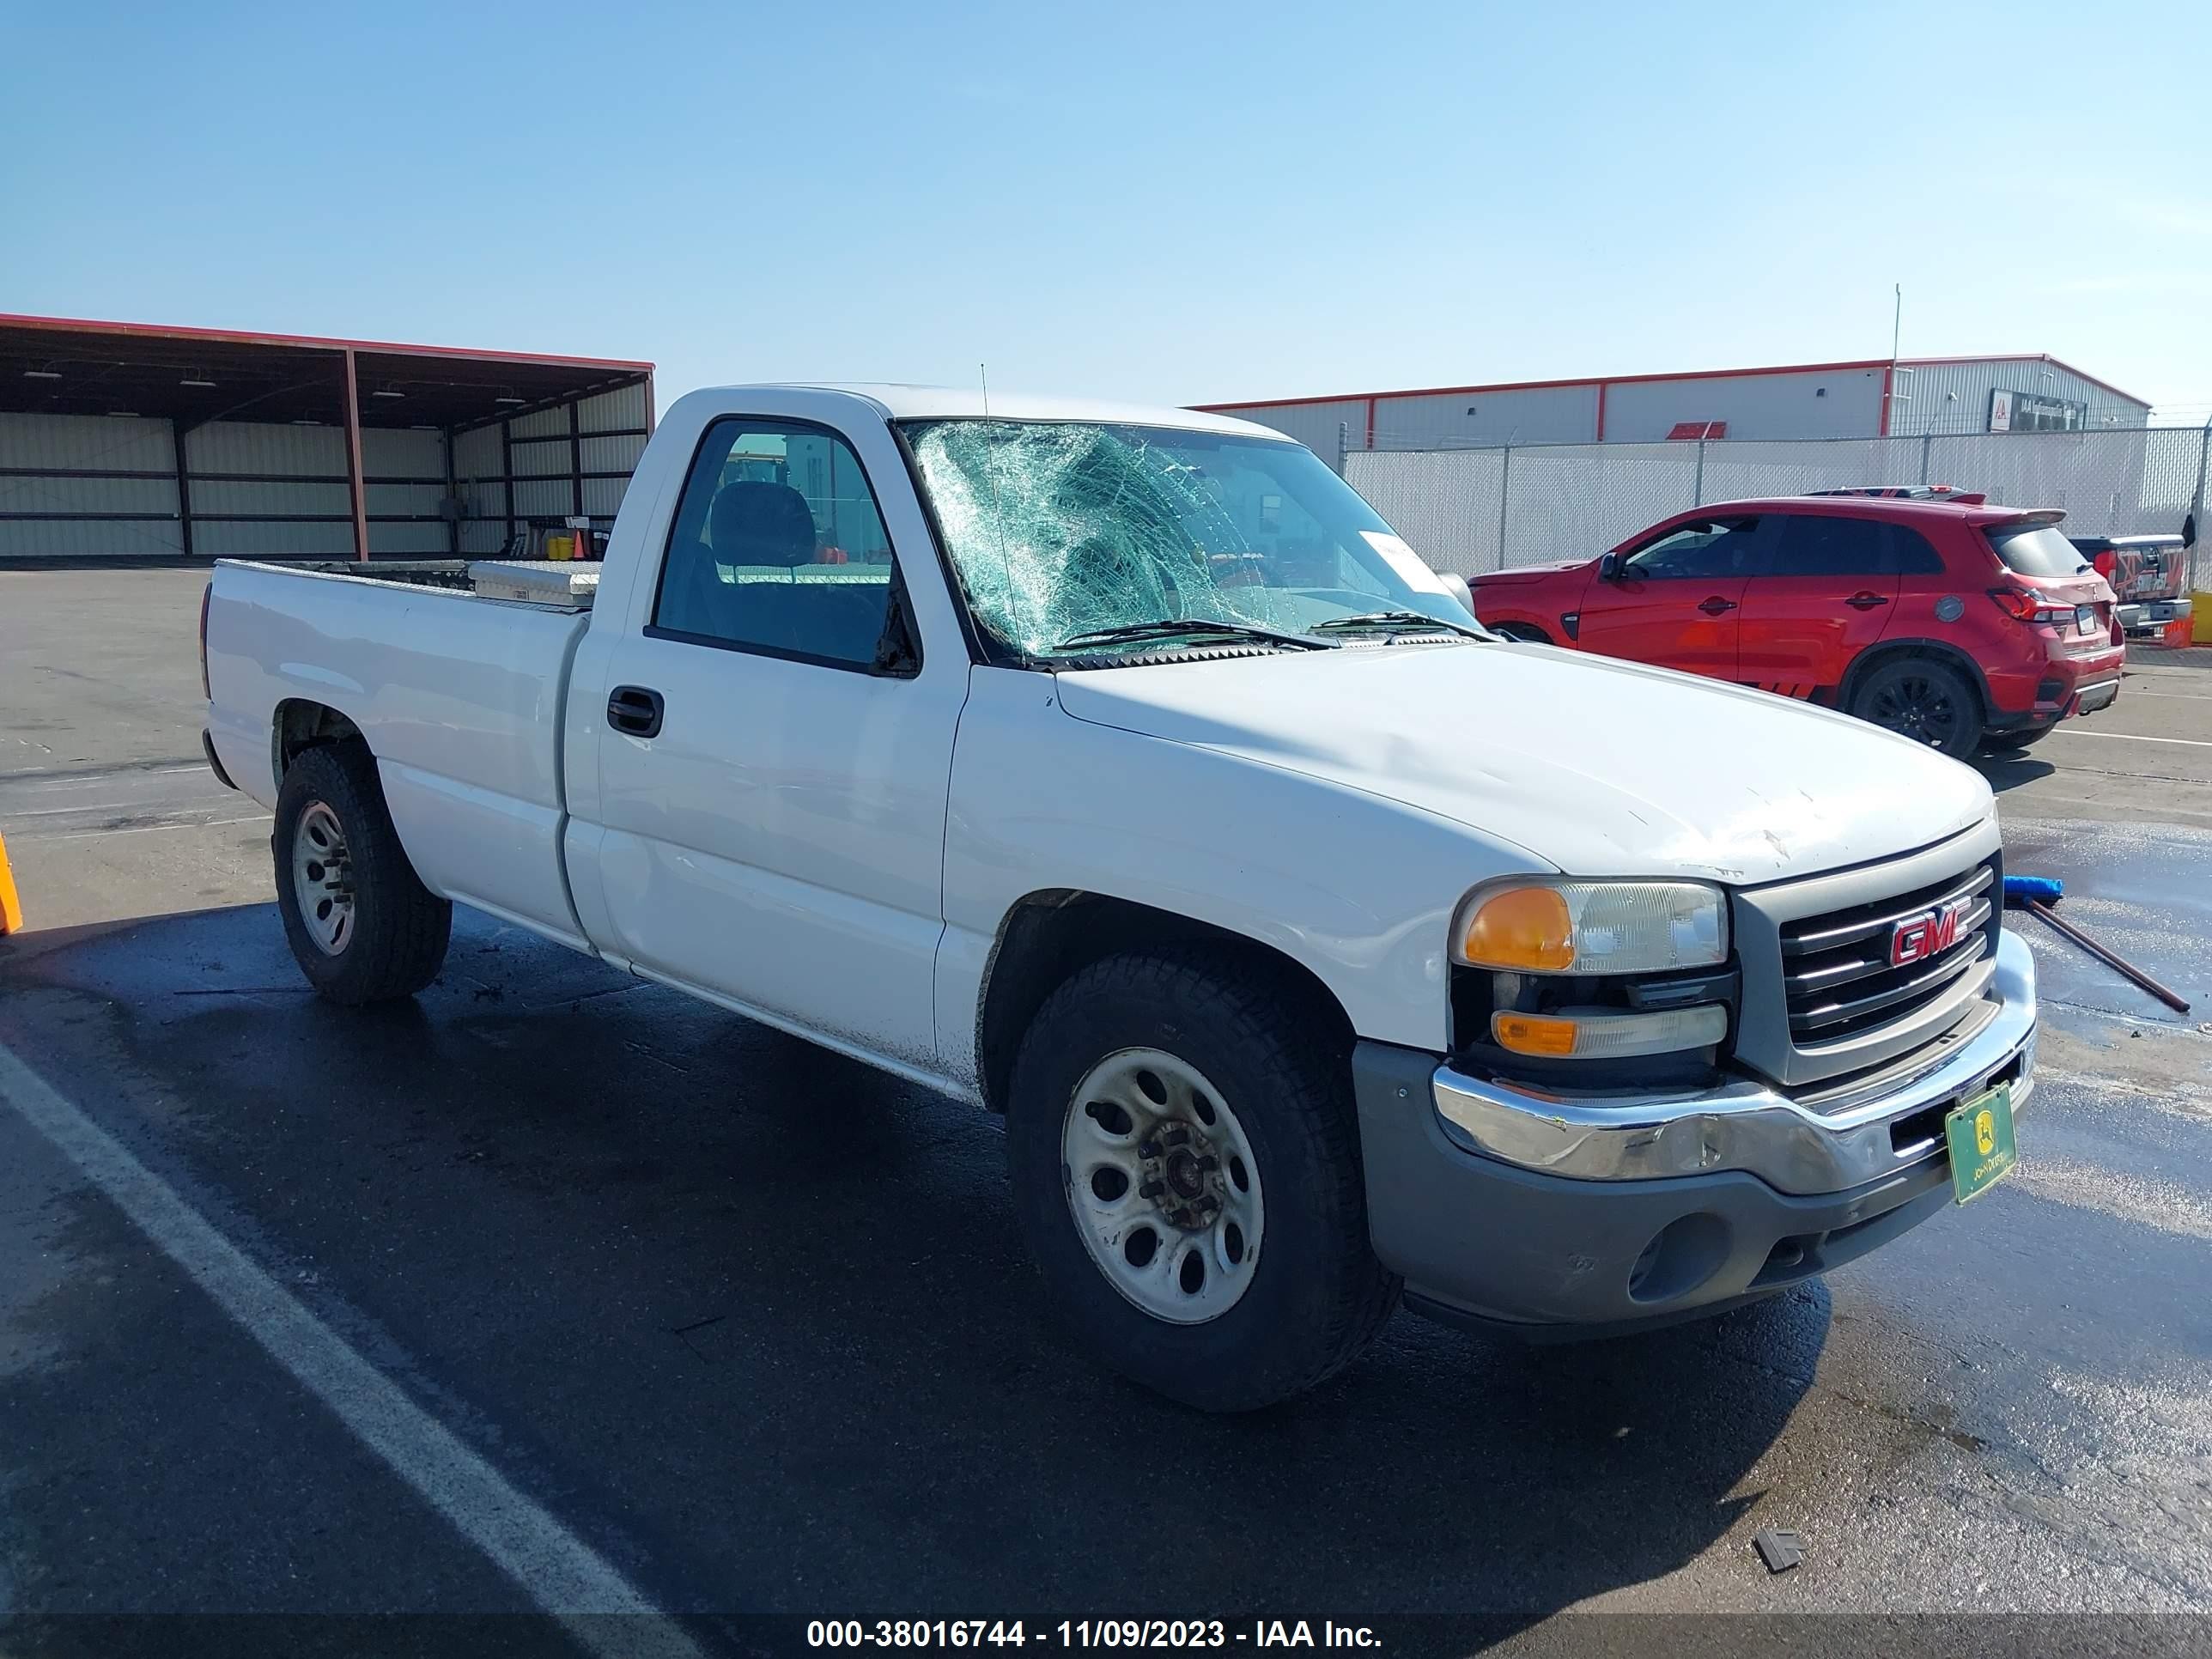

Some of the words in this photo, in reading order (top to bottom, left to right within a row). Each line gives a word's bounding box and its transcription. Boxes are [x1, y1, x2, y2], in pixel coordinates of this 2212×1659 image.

[1891, 896, 1972, 969] GMC
[1974, 1162, 1989, 1181] JOHN
[1988, 1152, 2004, 1172] DEERE
